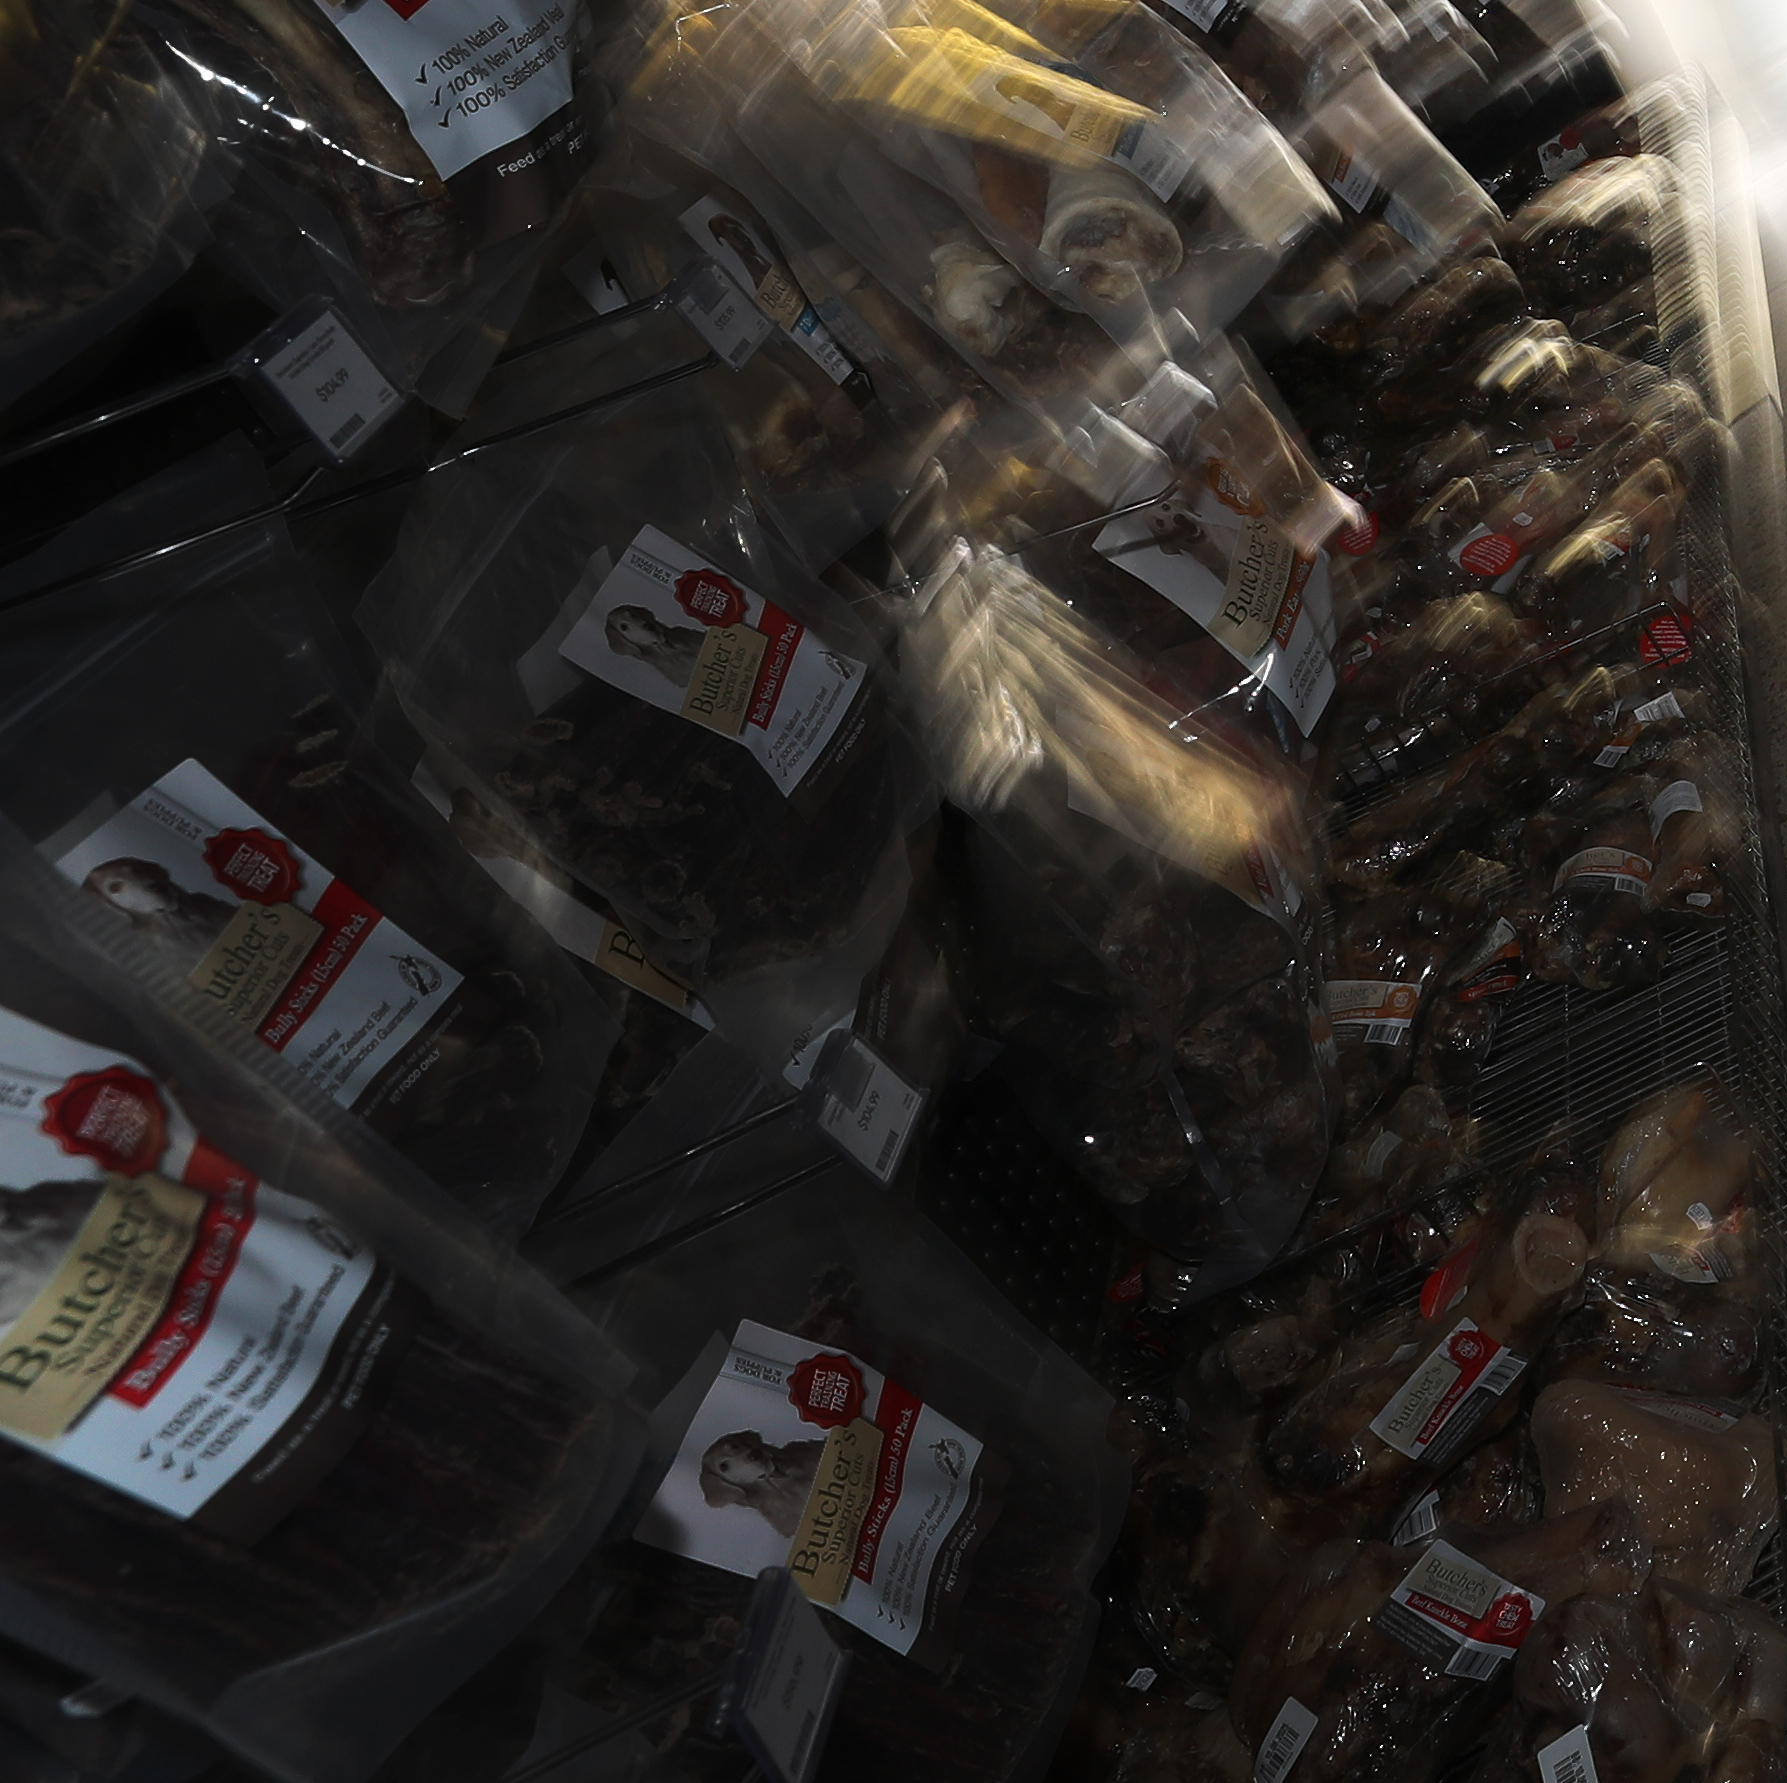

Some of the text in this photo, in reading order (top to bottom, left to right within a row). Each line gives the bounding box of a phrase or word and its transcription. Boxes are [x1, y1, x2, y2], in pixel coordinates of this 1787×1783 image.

[432, 14, 510, 74] 100% Natural
[447, 17, 550, 96] 100% New Zealand
[456, 45, 559, 117] 100% Satisfaction
[496, 152, 536, 177] Feed
[709, 589, 730, 618] TREAT
[1222, 519, 1269, 628] Butcher's
[1276, 611, 1294, 640] Pork
[690, 629, 737, 716] Butcher's
[752, 622, 798, 723] Bully Pack
[263, 913, 369, 1045] Bully Sticks Pack
[808, 1368, 826, 1408] PERFECT
[829, 1375, 851, 1413] TREAT
[1388, 1366, 1442, 1434] Butcher's
[792, 1429, 857, 1579] Butcher's
[858, 1407, 913, 1575] Bully Sticks (15cm) Pack
[821, 1490, 855, 1566] Superior
[1425, 1558, 1489, 1597] Butcher's
